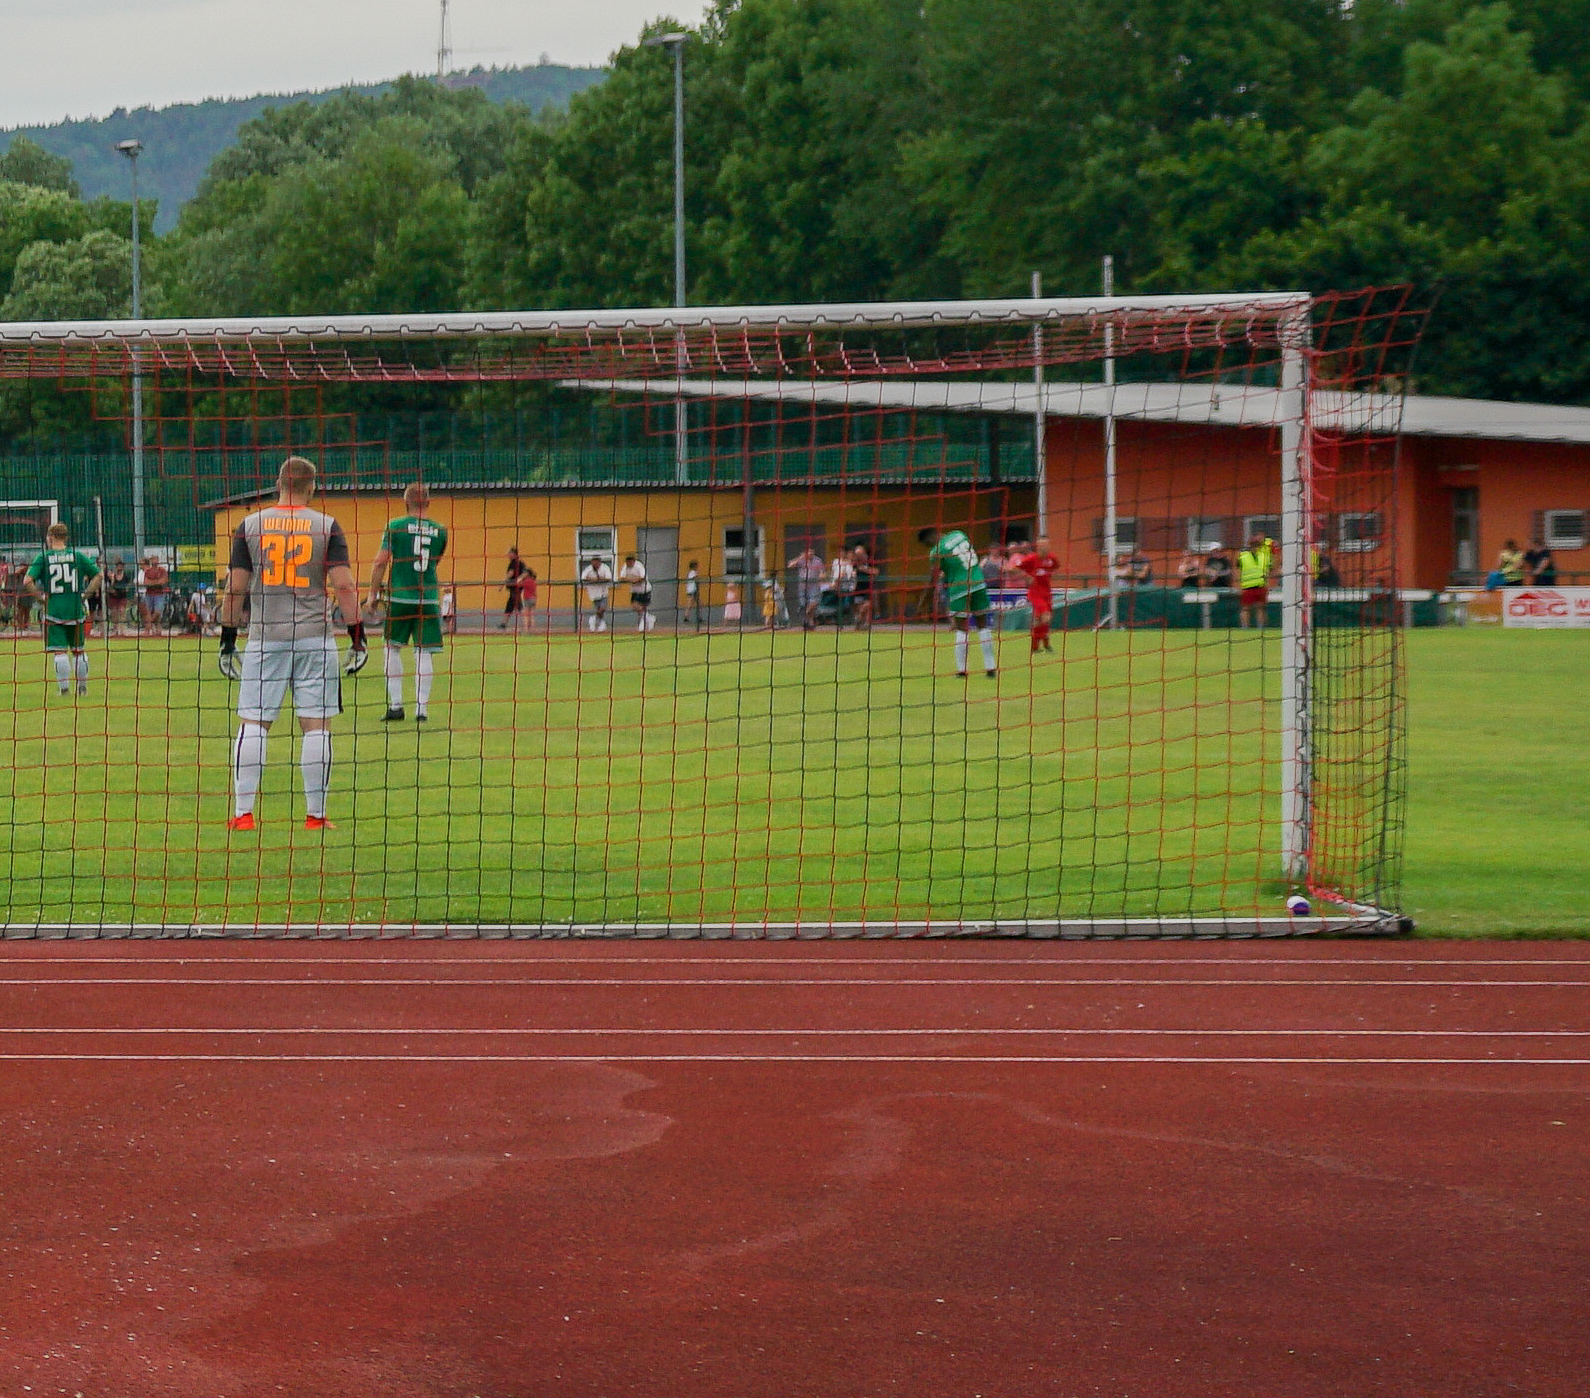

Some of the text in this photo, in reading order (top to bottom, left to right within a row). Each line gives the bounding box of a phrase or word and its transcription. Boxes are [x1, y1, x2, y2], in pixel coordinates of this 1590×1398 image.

[262, 534, 313, 588] 32
[413, 535, 431, 572] 5
[49, 564, 78, 594] 24
